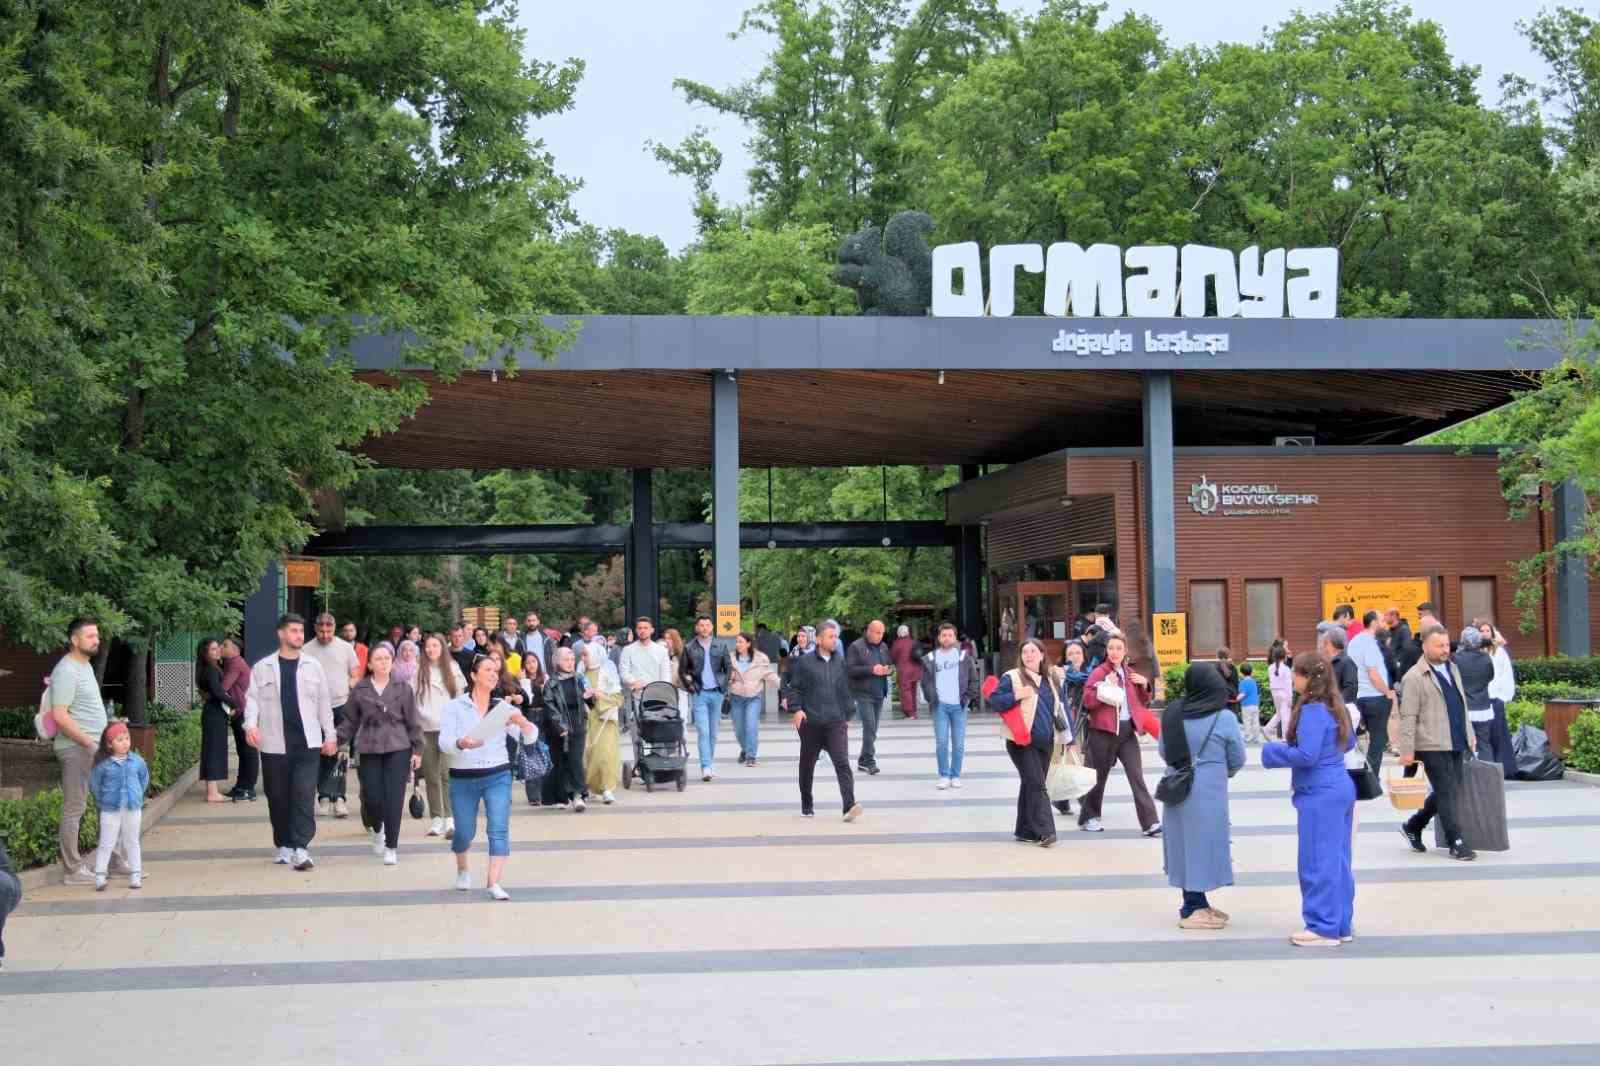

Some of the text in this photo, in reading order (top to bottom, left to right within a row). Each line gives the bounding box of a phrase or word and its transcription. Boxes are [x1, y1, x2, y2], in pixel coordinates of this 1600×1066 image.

[931, 241, 1339, 319] ormanya
[1052, 329, 1230, 356] doğayla başbaşa
